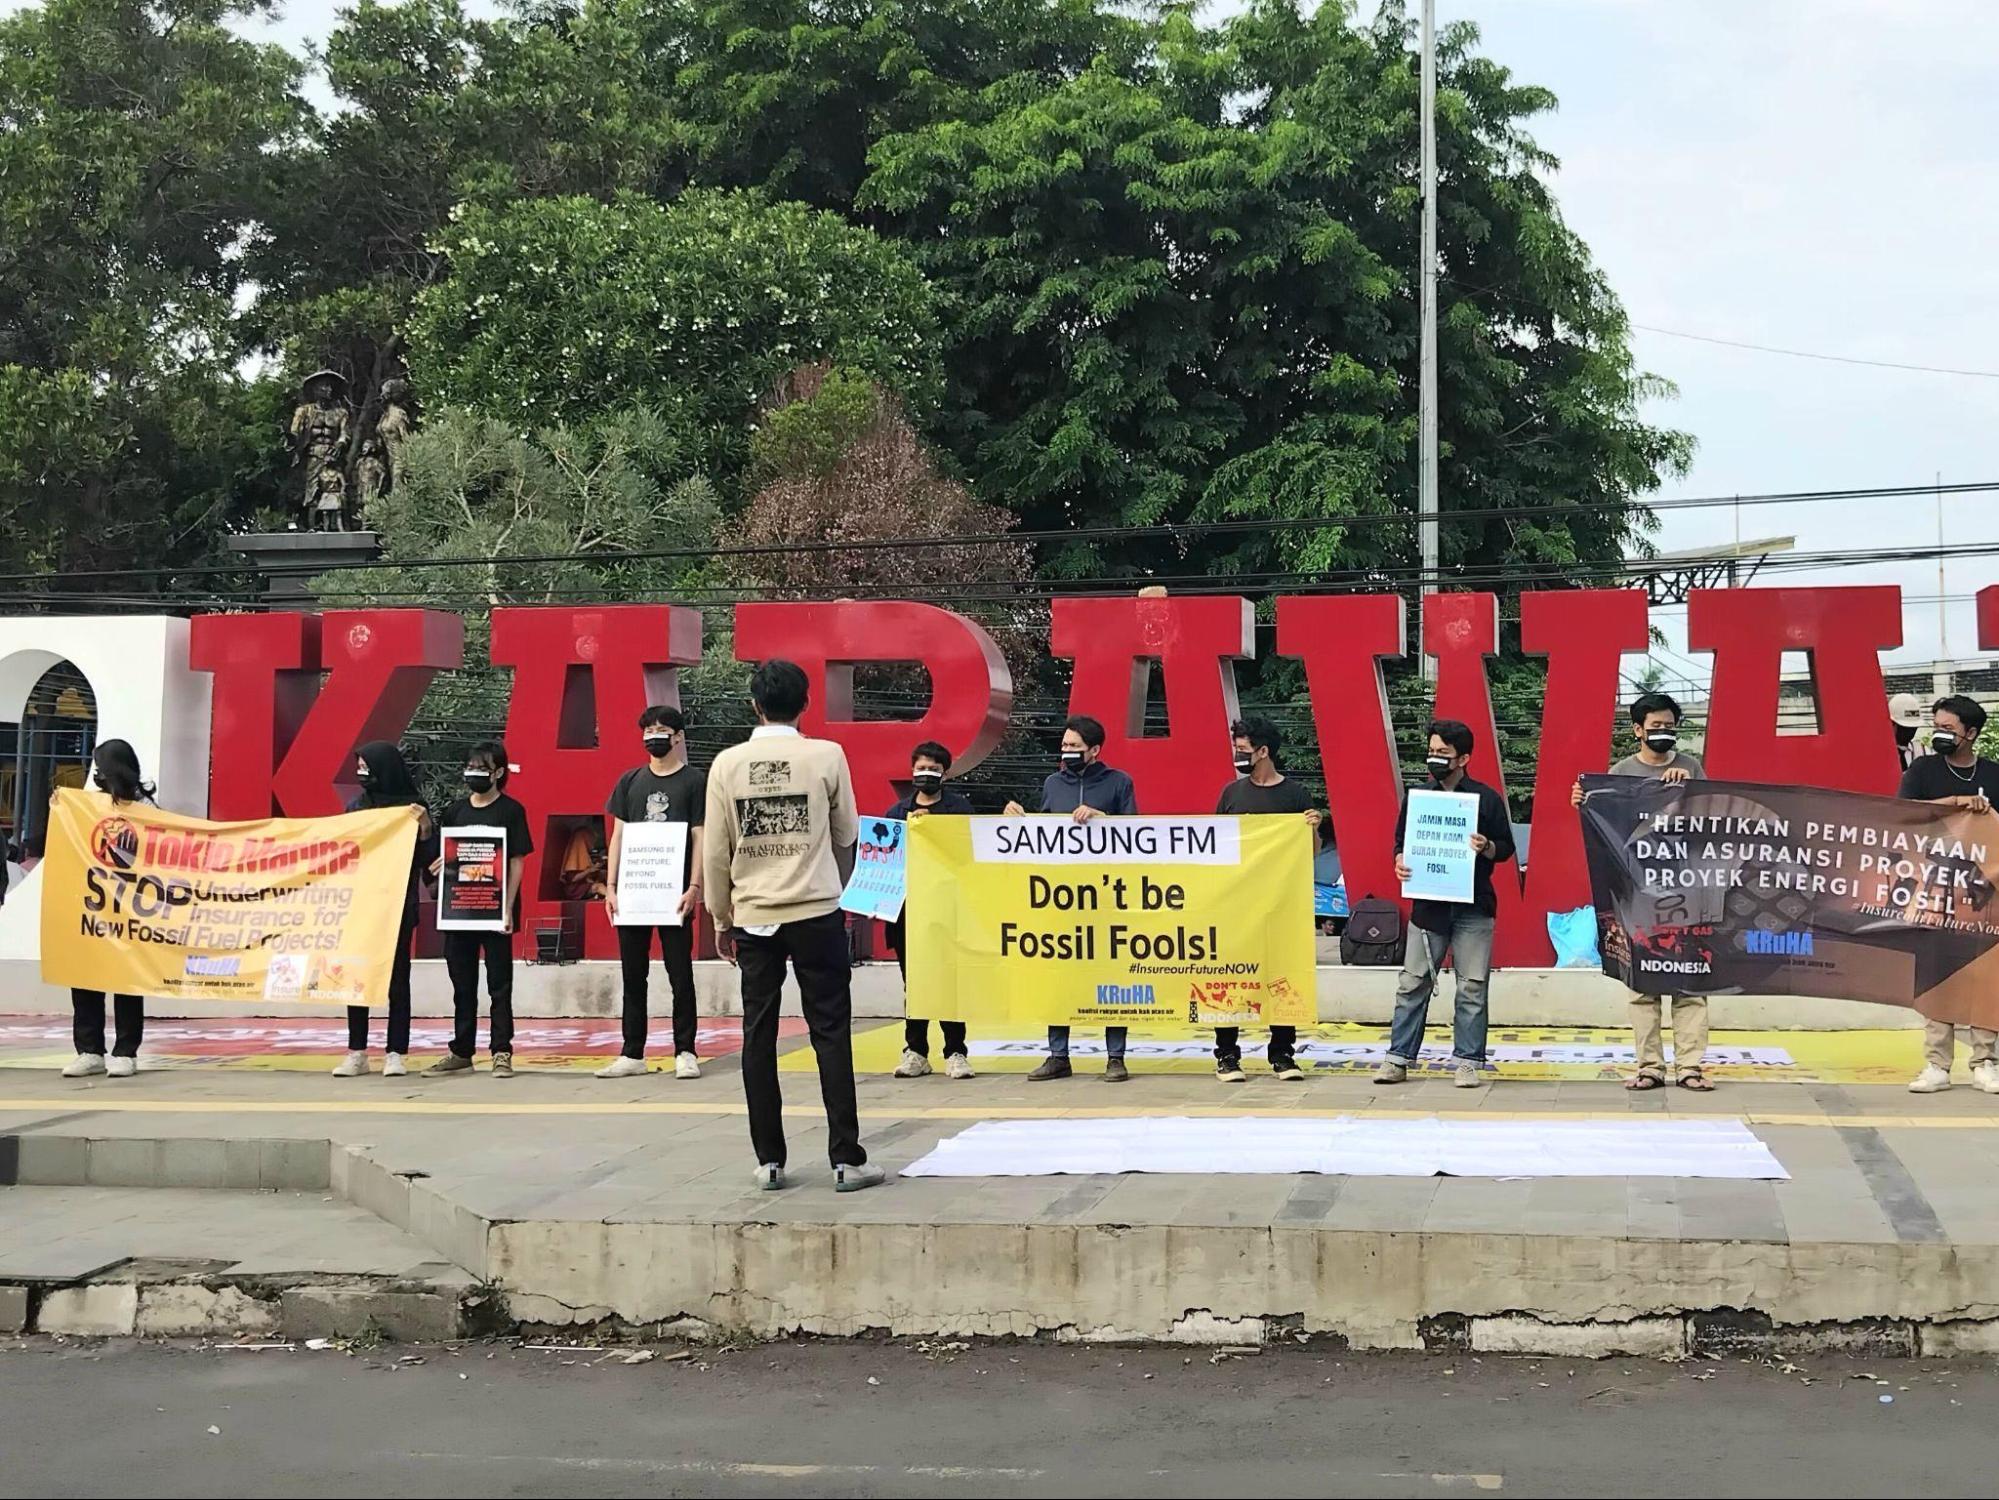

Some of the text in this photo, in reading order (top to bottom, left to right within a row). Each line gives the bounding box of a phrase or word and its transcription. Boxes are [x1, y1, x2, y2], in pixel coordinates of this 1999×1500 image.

[1417, 814, 1466, 827] JAMIN MASA
[143, 824, 361, 876] Tokio Marine
[628, 846, 664, 854] SAMSUNG
[996, 825, 1217, 855] SAMSUNG FM
[1416, 830, 1441, 841] DEPAN
[1638, 812, 1987, 864] "HENTIKAN PEMBIAYAAN
[1411, 846, 1467, 859] BUKAN PROYEK
[1637, 840, 1985, 888] DAN ASURANSI PROYEK-
[625, 870, 656, 878] BEYOND
[84, 866, 193, 920] STOP
[194, 879, 353, 907] Underwriting
[1141, 875, 1185, 910] be
[1645, 868, 1973, 915] PROYEK ENERGI FOSIL"
[313, 906, 348, 926] for
[81, 913, 343, 951] New Fossil Fuel Projects!
[1000, 922, 1218, 961] Fossil Fools!
[1097, 985, 1156, 1005] KRuHA
[1240, 982, 1262, 990] GAS
